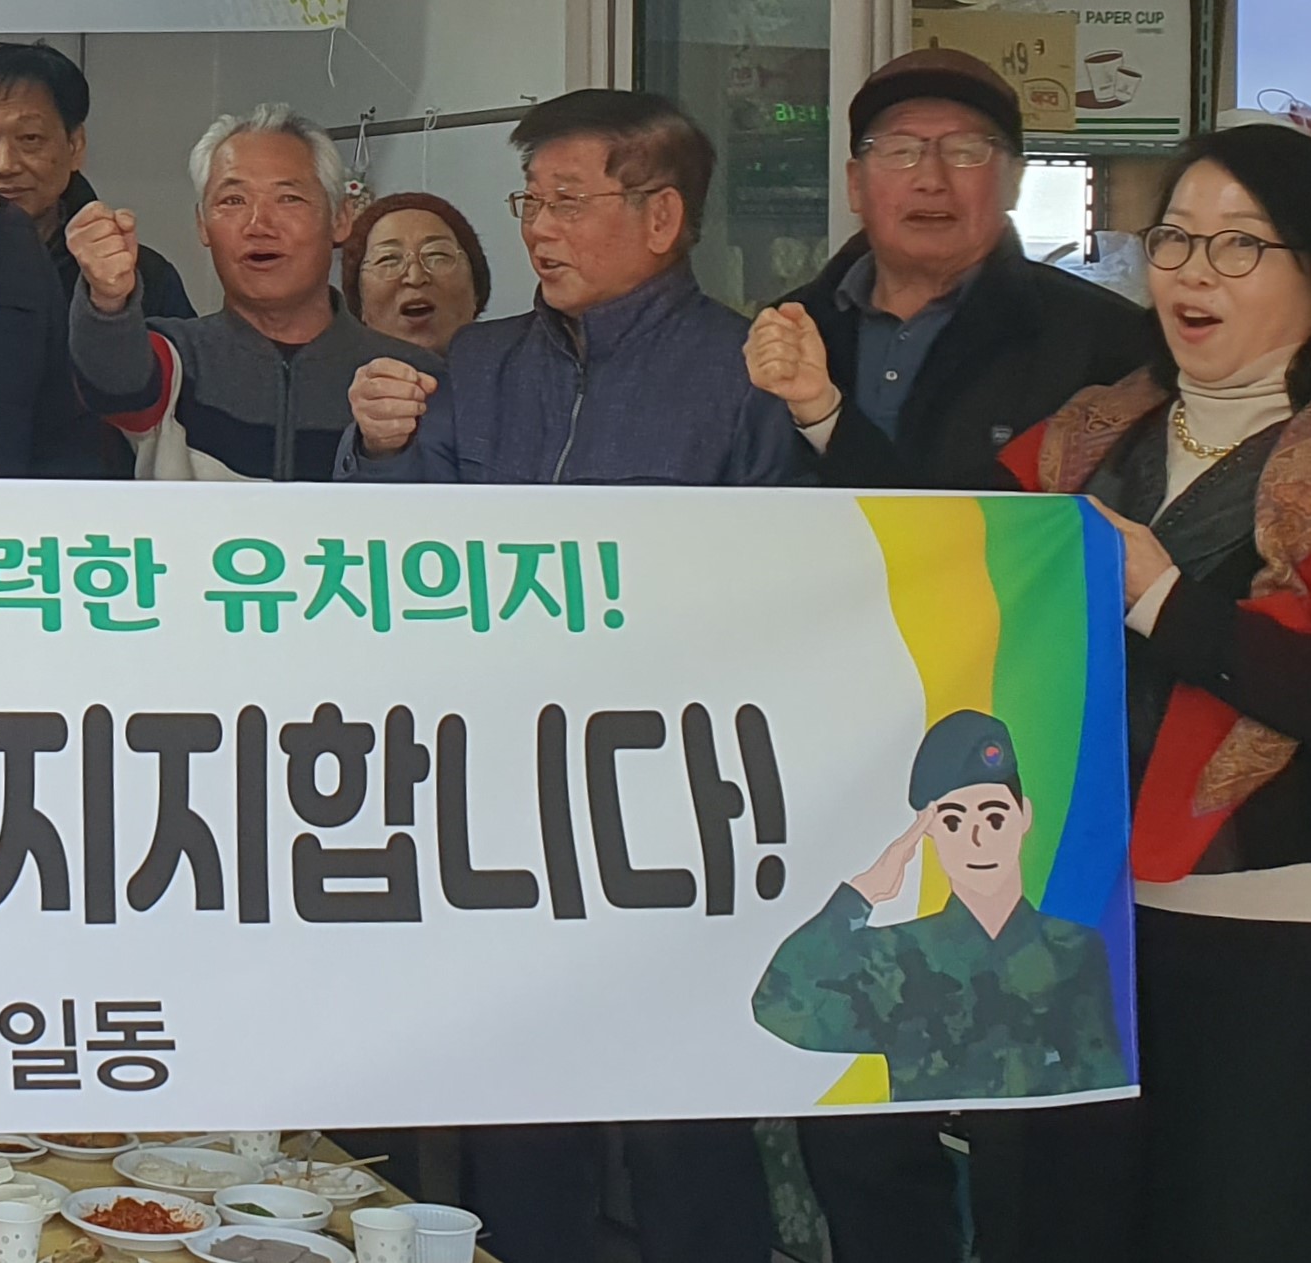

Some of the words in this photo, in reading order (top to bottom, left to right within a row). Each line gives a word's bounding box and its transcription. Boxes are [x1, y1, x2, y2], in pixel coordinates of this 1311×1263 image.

[1086, 11, 1132, 25] PAPER
[1135, 12, 1165, 25] CUP
[205, 538, 625, 634] 유치의지!
